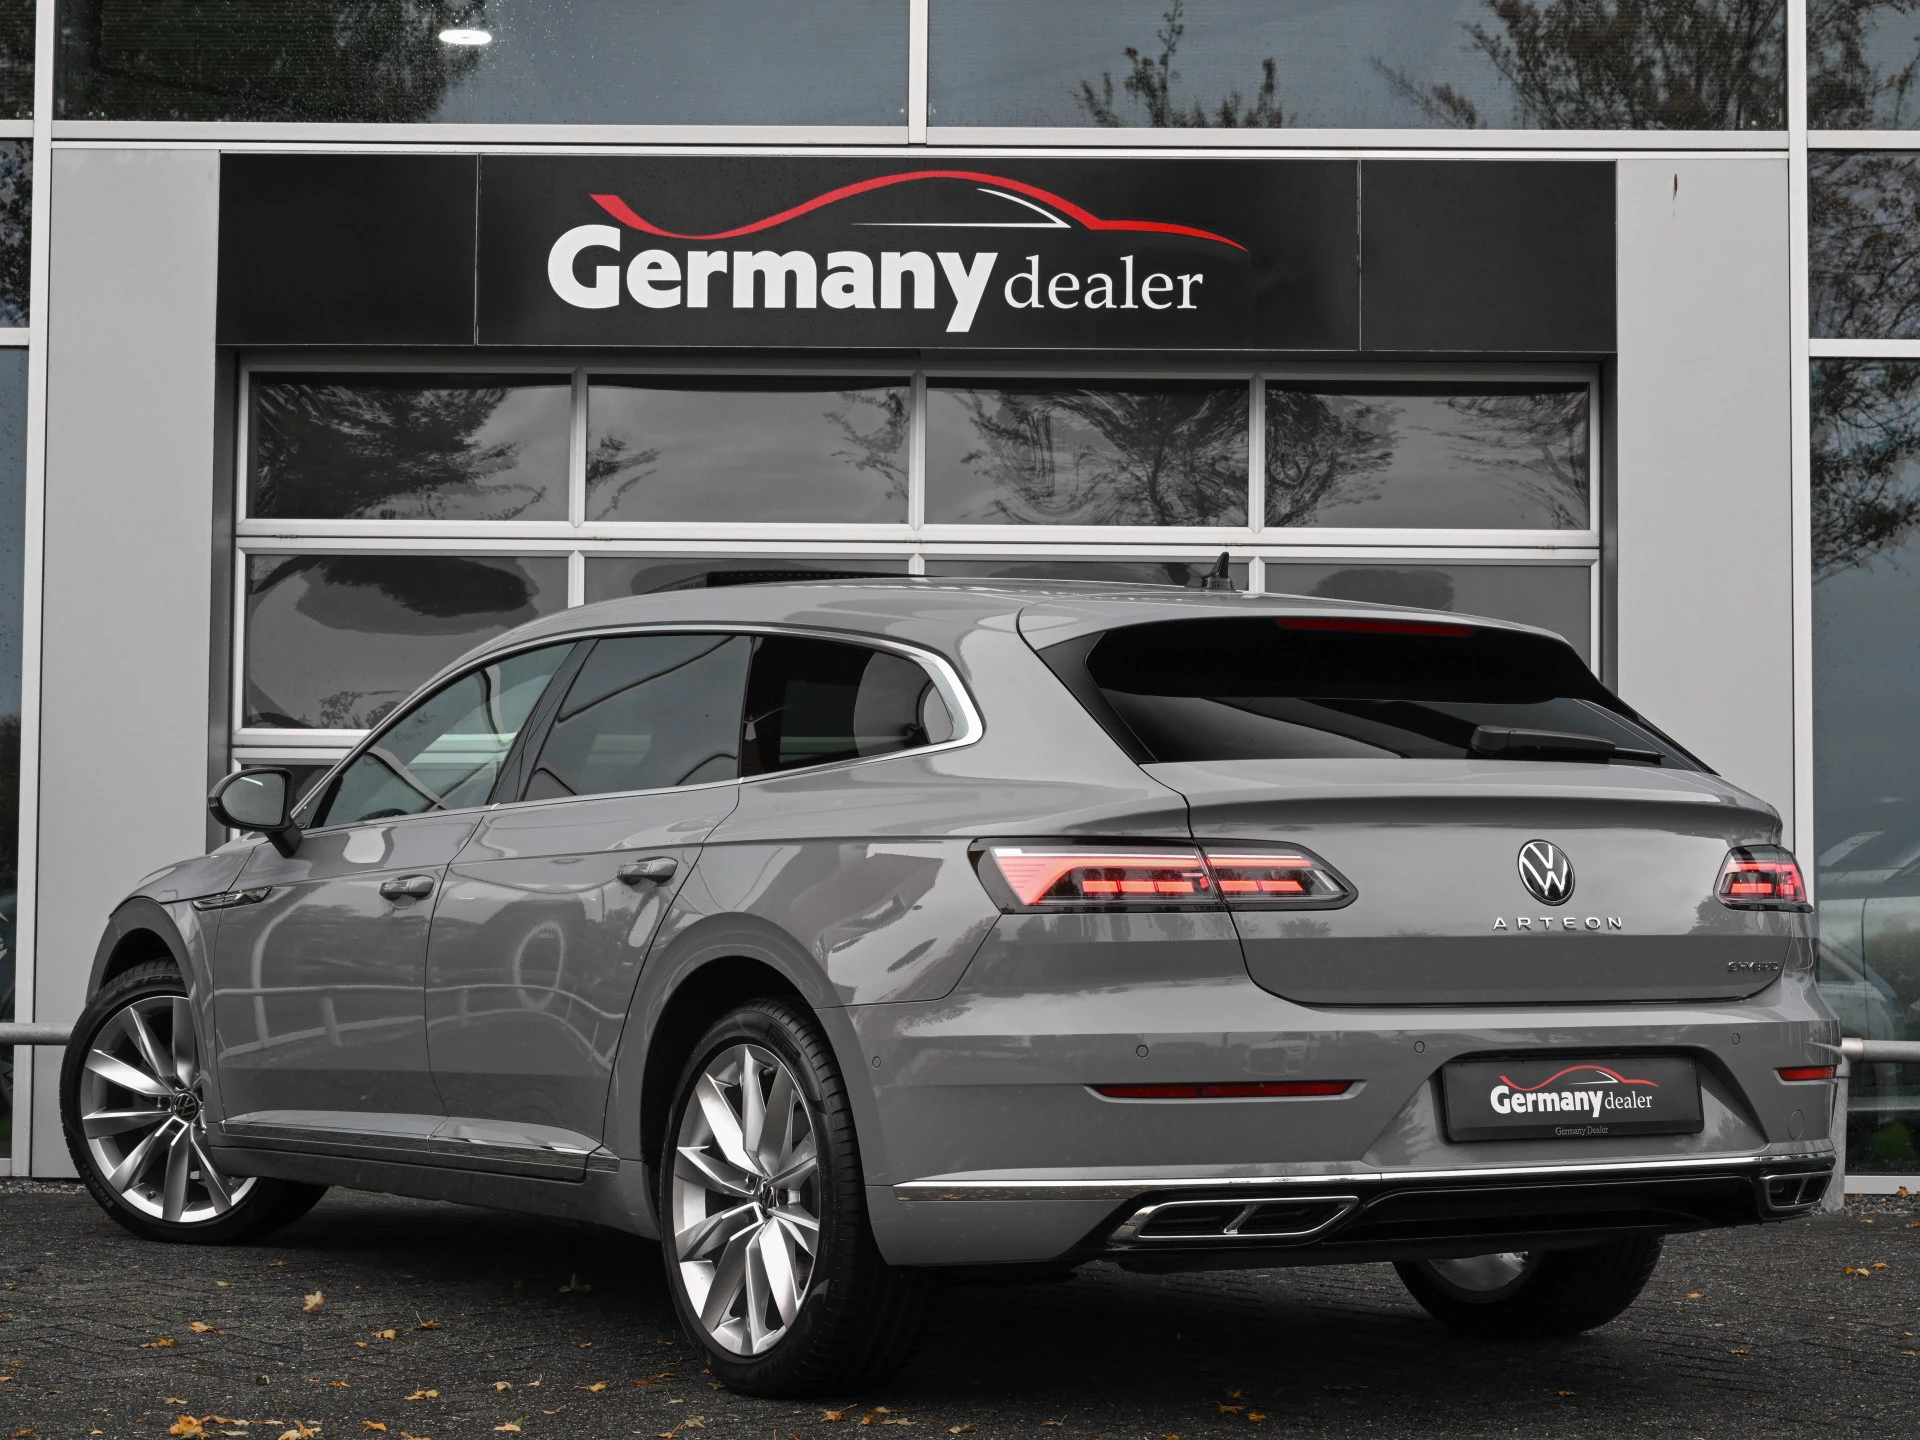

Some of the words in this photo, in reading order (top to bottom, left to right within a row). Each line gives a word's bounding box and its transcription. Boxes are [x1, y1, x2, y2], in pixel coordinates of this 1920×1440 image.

[547, 224, 998, 333] Germany
[1004, 255, 1204, 310] dealer
[1493, 916, 1622, 931] ARTEON
[1489, 1085, 1603, 1118] Germany
[1604, 1091, 1653, 1110] dealer
[1555, 1126, 1586, 1136] Germany
[1586, 1125, 1609, 1135] Dealer
